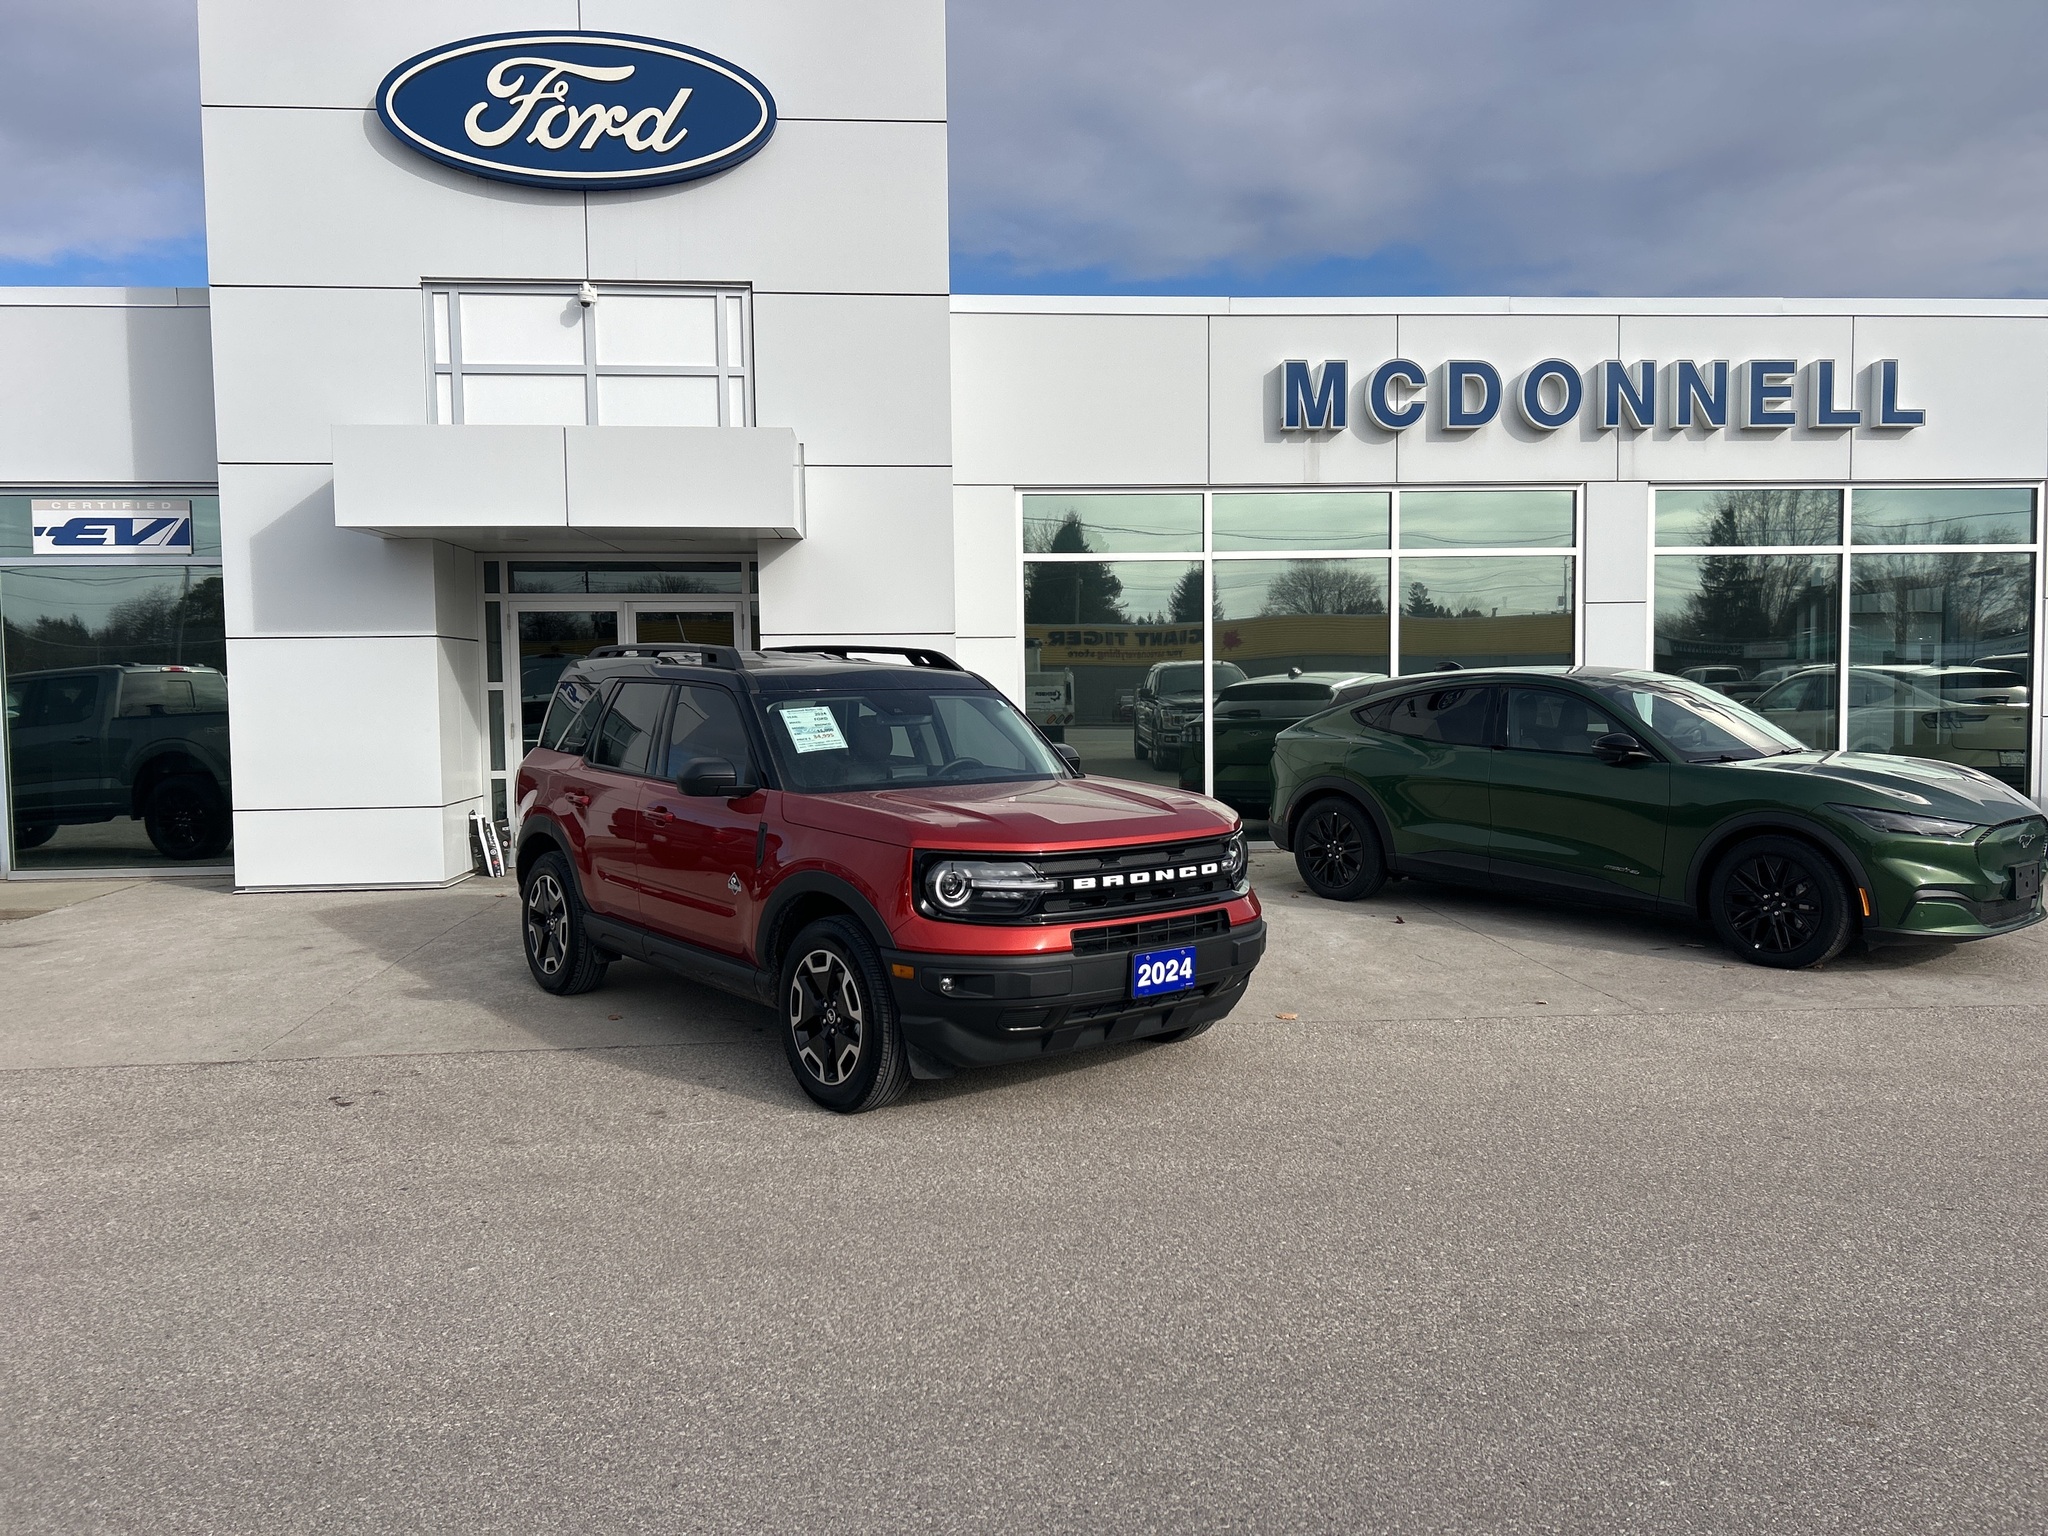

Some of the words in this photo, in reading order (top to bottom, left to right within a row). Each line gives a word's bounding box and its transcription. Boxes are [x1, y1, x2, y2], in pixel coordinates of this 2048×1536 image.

[464, 56, 693, 153] Ford
[1279, 358, 1926, 432] MCDONNELL
[51, 501, 172, 510] CERTIFIED
[1073, 863, 1218, 889] BRONCO
[1137, 956, 1193, 988] 2024
